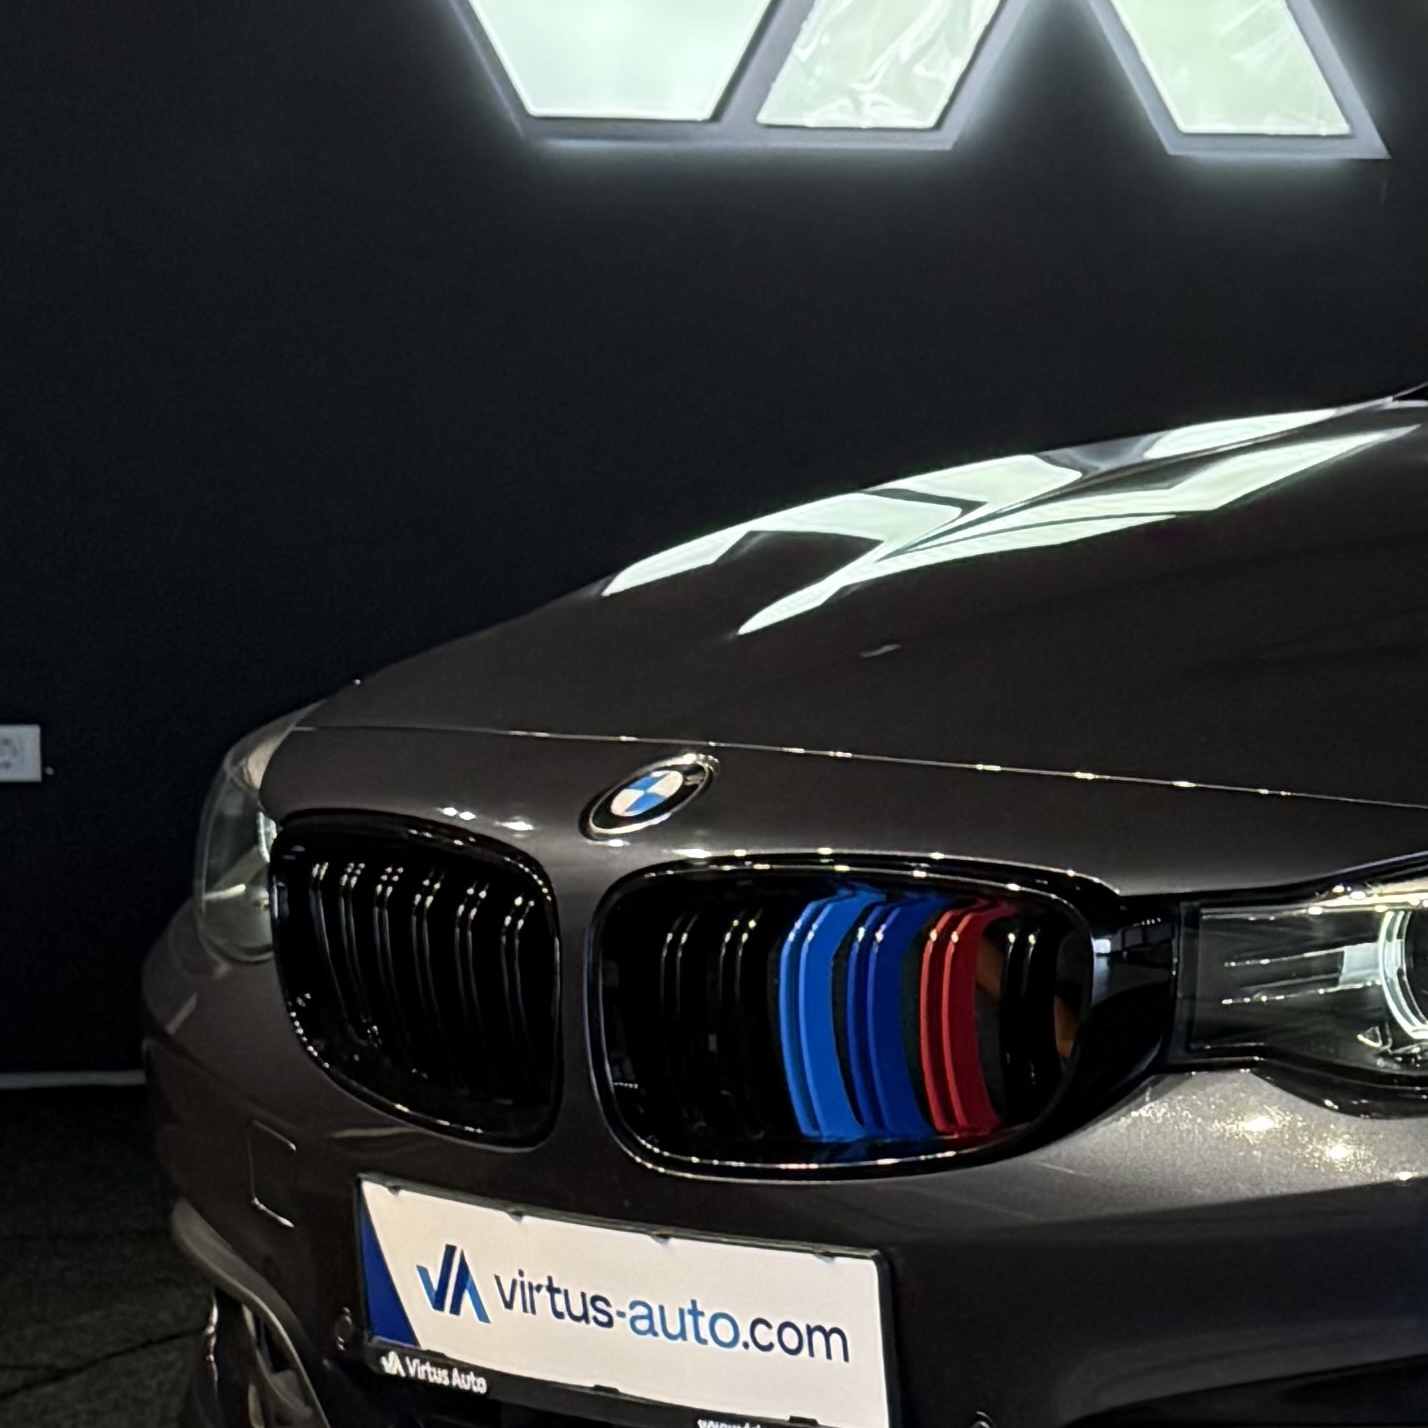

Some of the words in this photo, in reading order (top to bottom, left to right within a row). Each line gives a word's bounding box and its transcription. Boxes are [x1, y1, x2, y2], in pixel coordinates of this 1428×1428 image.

[493, 1267, 851, 1363] virtus-auto.com
[404, 1355, 450, 1386] Virtus
[451, 1367, 488, 1395] Auto
